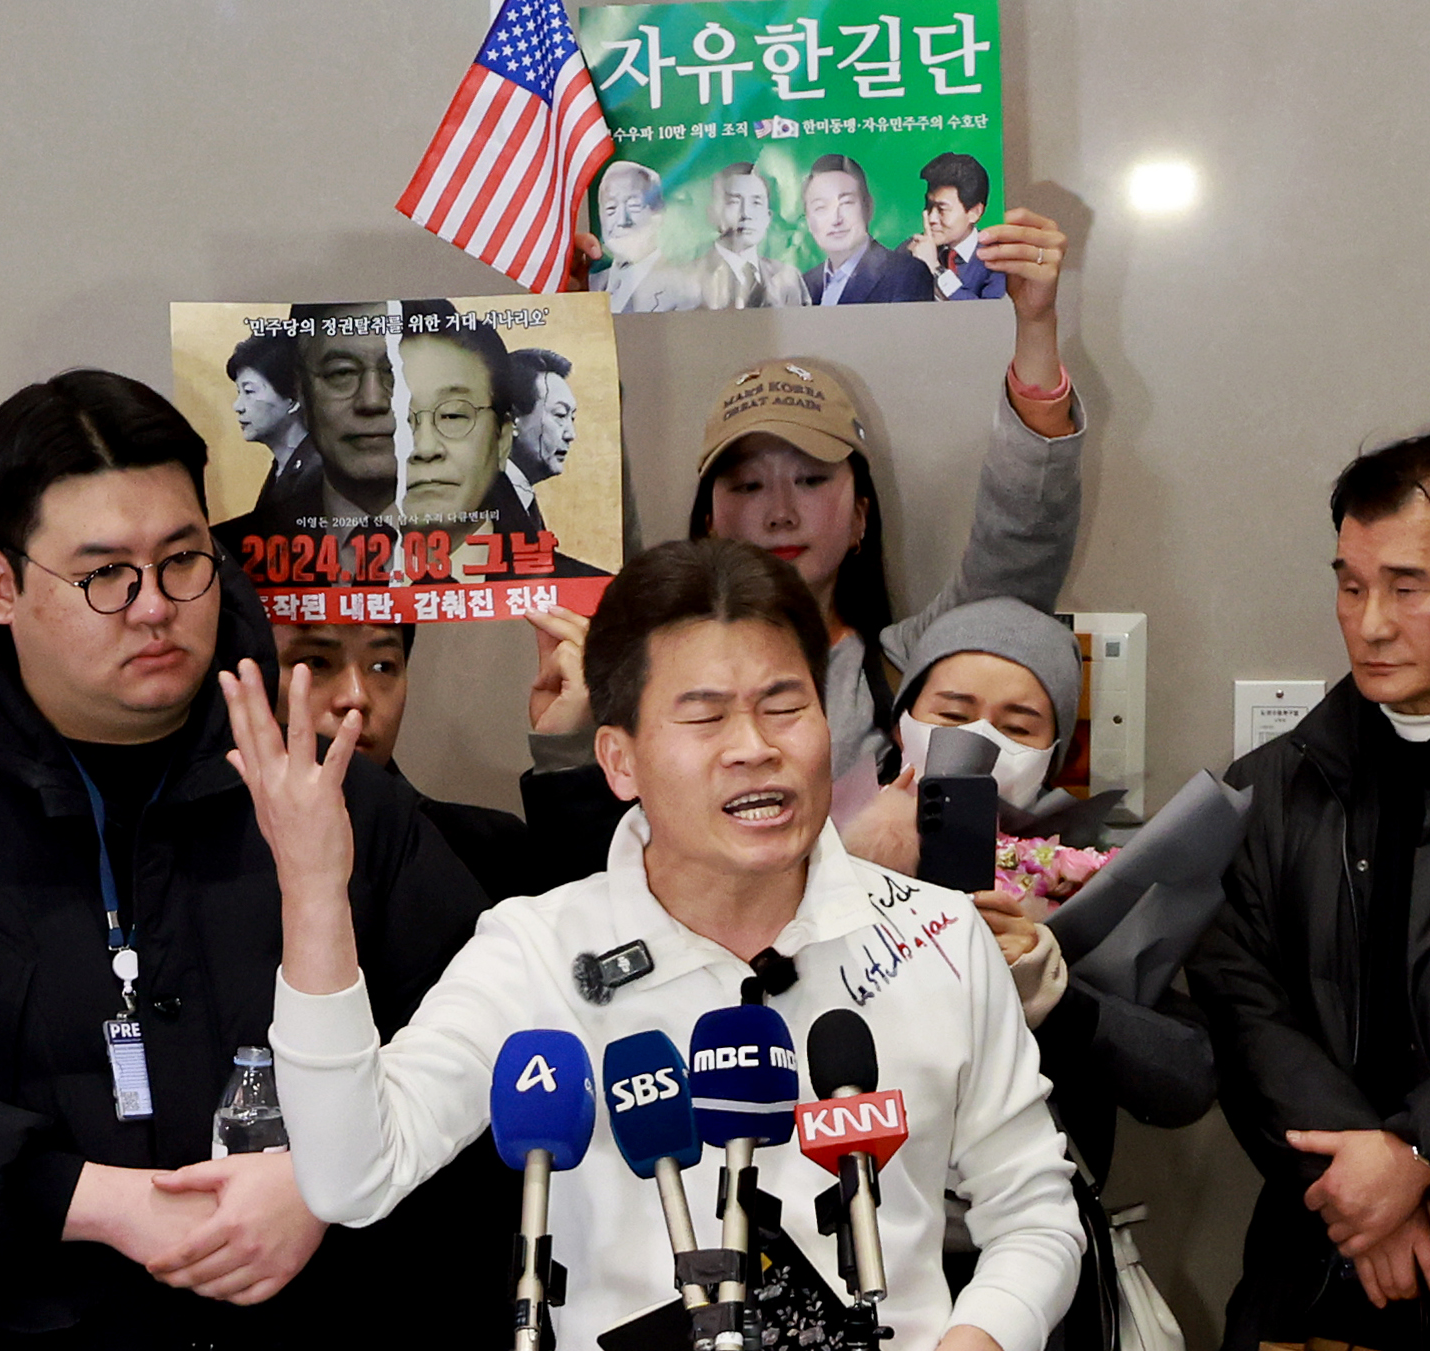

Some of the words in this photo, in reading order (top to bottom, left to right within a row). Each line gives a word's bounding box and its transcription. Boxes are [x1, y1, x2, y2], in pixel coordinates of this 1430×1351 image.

[599, 12, 991, 109] 자유한길단
[609, 126, 654, 143] 수우파
[659, 124, 686, 140] 10만
[721, 121, 749, 137] 조직
[947, 113, 989, 129] 수호단
[408, 313, 441, 333] 위한
[445, 312, 477, 332] 거대
[240, 531, 453, 583] 2024.12.03
[462, 530, 559, 576] 그날
[339, 592, 403, 624] 내란,
[693, 1045, 760, 1073] MBC
[611, 1066, 680, 1114] SBS
[802, 1098, 900, 1142] KNN
